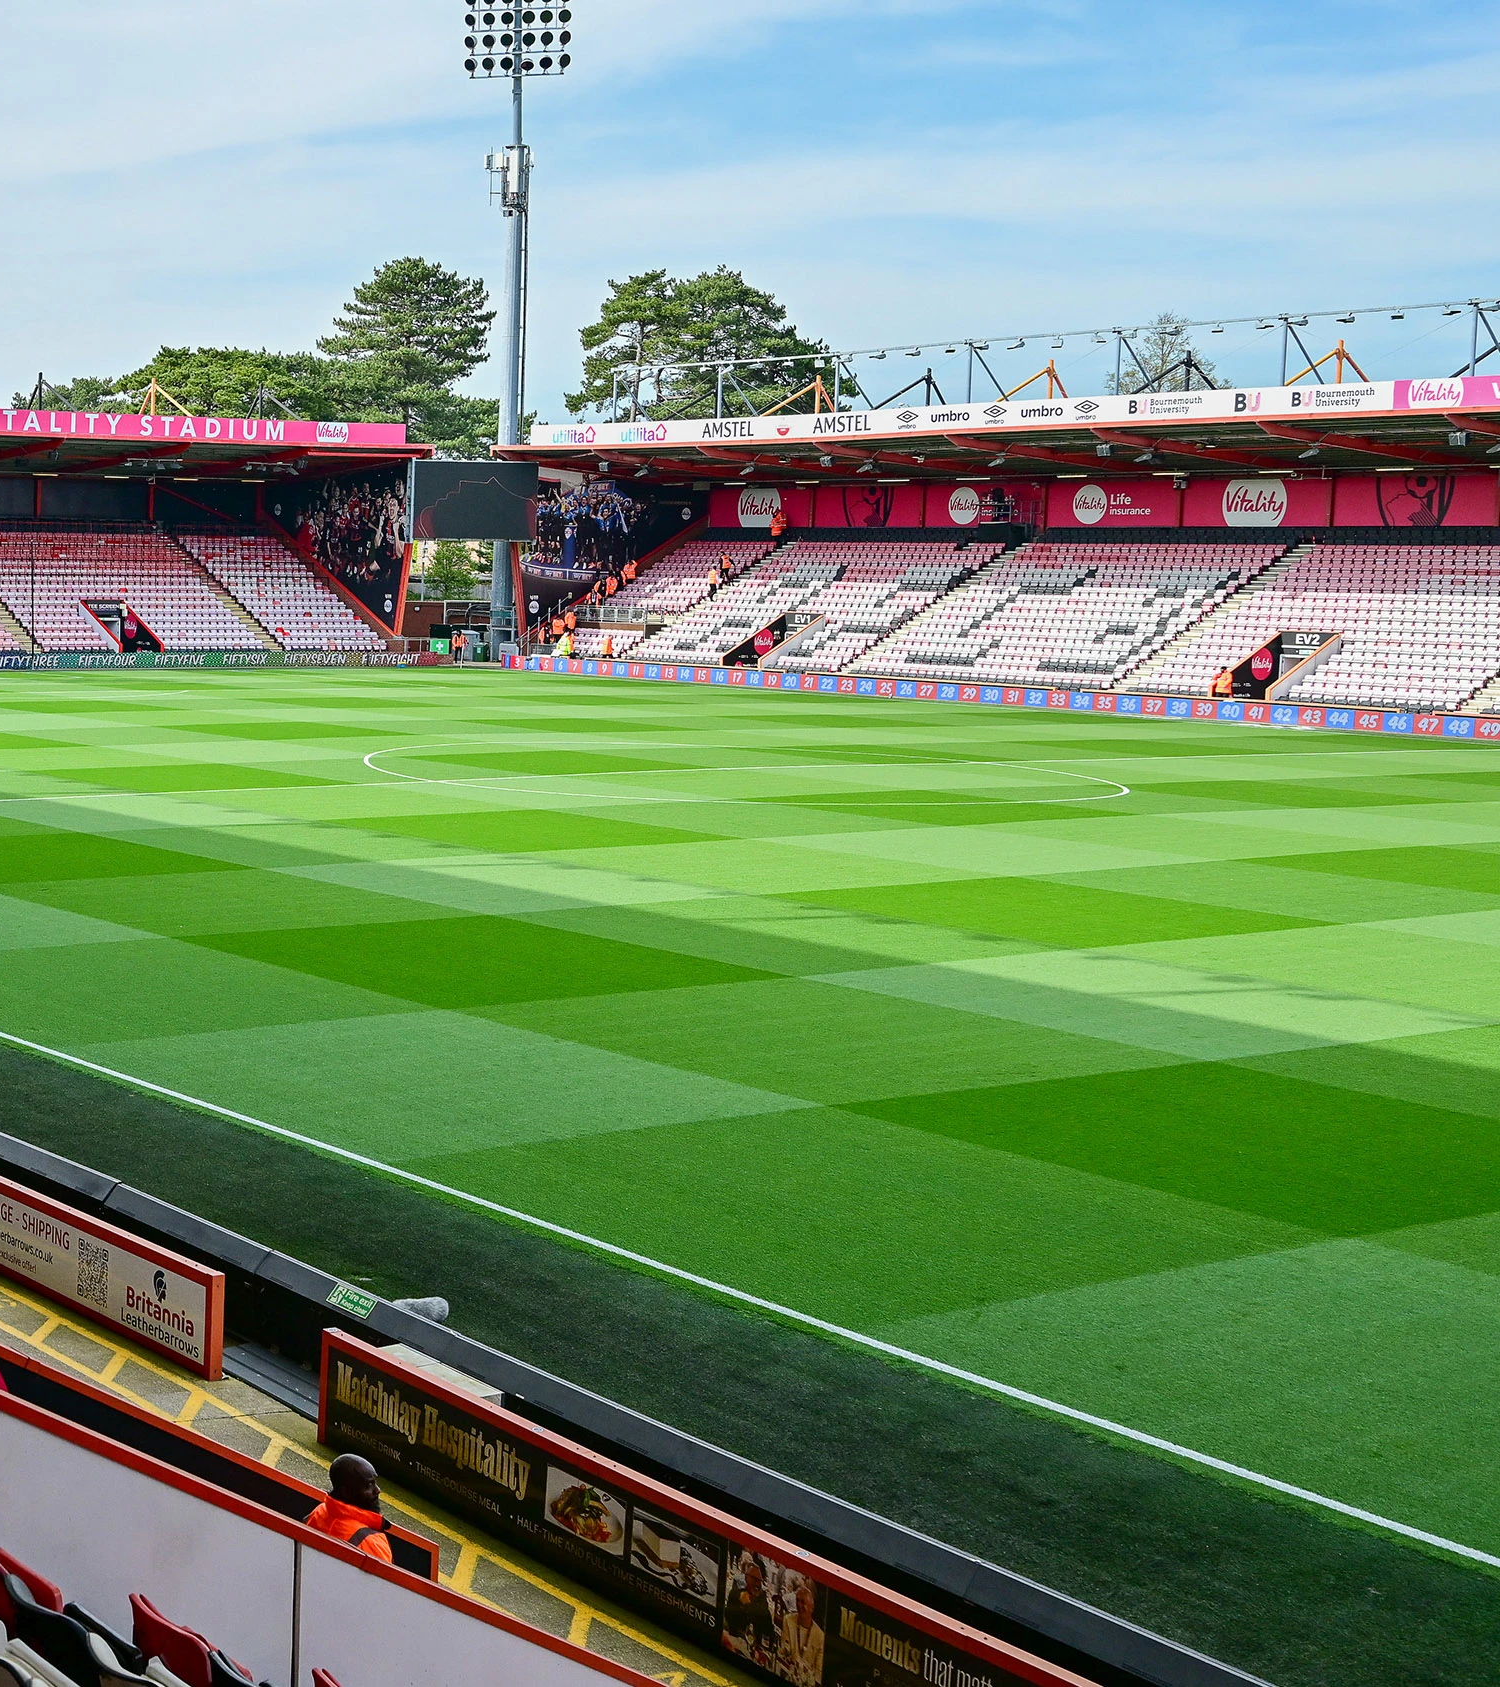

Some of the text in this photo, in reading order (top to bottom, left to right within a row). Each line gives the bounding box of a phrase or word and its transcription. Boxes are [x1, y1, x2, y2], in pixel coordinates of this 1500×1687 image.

[1291, 388, 1375, 408] BU Bournemouth
[1411, 379, 1461, 406] Vitality
[1129, 396, 1203, 415] BU Bournemouth
[1150, 405, 1190, 415] University
[1234, 392, 1261, 413] BU
[1315, 397, 1361, 408] University
[930, 410, 970, 424] umbro
[1021, 406, 1064, 419] umbro
[140, 415, 285, 441] STADIUM
[316, 422, 348, 442] Vitality
[621, 424, 655, 442] utilita
[702, 421, 754, 438] AMSTEL
[813, 415, 871, 434] AMSTEL
[552, 427, 585, 445] utilita
[740, 494, 780, 517] Vitality
[950, 496, 979, 516] Vitality
[1074, 494, 1106, 515] Vitality
[1110, 493, 1132, 504] Life
[1226, 485, 1284, 521] Vitality
[1109, 507, 1151, 516] insurance
[794, 615, 810, 624] EV1
[754, 635, 774, 650] Vitality
[1295, 634, 1320, 646] EV2
[78, 656, 137, 667] FIFTYFOUR
[154, 655, 206, 666] FIFTYFIVE
[222, 654, 268, 666] FIFTYSIX
[284, 654, 346, 666] FIFTYSEVEN
[362, 654, 420, 666] FIFTYEIGHT
[1251, 656, 1272, 673] Vitality
[514, 658, 520, 667] 3
[544, 660, 549, 669] 5
[558, 661, 564, 670] 6
[572, 662, 578, 670] 7
[587, 662, 592, 672] 8
[602, 664, 608, 673] 9
[616, 664, 624, 674] 10
[632, 666, 640, 676] 11
[648, 667, 658, 676] 12
[664, 668, 674, 678] 13
[680, 669, 690, 679] 14
[698, 670, 706, 680] 15
[716, 671, 724, 682] 16
[732, 672, 742, 683] 17
[750, 674, 758, 684] 18
[768, 674, 778, 686] 19
[784, 676, 796, 686] 20
[804, 677, 814, 688] 21
[821, 678, 834, 690] 22
[841, 680, 854, 692] 23
[860, 682, 872, 692] 24
[880, 682, 892, 694] 25
[900, 683, 912, 695] 26
[920, 685, 934, 696] 27
[941, 686, 956, 698] 28
[962, 688, 977, 700] 29
[984, 689, 999, 701] 30
[1006, 690, 1020, 702] 31
[1028, 692, 1043, 704] 32
[1050, 694, 1066, 706] 33
[1073, 695, 1089, 708] 34
[1097, 696, 1112, 709] 35
[1120, 698, 1136, 710] 36
[1146, 700, 1162, 712] 37
[1170, 701, 1188, 714] 38
[1196, 703, 1213, 716] 39
[1221, 704, 1240, 718] 40
[1248, 706, 1264, 720] 41
[1274, 708, 1292, 723] 42
[1302, 710, 1322, 724] 43
[1328, 712, 1349, 727] 44
[1359, 714, 1379, 728] 45
[1388, 716, 1407, 730] 46
[1418, 718, 1439, 732] 47
[1448, 719, 1470, 735] 48
[1480, 721, 1500, 736] 49
[22, 1212, 70, 1250] SHIPPING
[341, 1299, 368, 1316] Keep clear
[345, 1290, 374, 1309] Fire exit
[125, 1286, 194, 1336] Britannia
[120, 1307, 200, 1360] Leatherbarrows
[336, 1360, 531, 1502] Matchday Hospitality
[340, 1421, 401, 1462] WELCOME DRINK
[416, 1461, 502, 1516] THREE-COURSE MEAL
[516, 1514, 716, 1629] HALF-TIME AND FULL-TIME REFRESHMENTS
[840, 1606, 922, 1676] Moments
